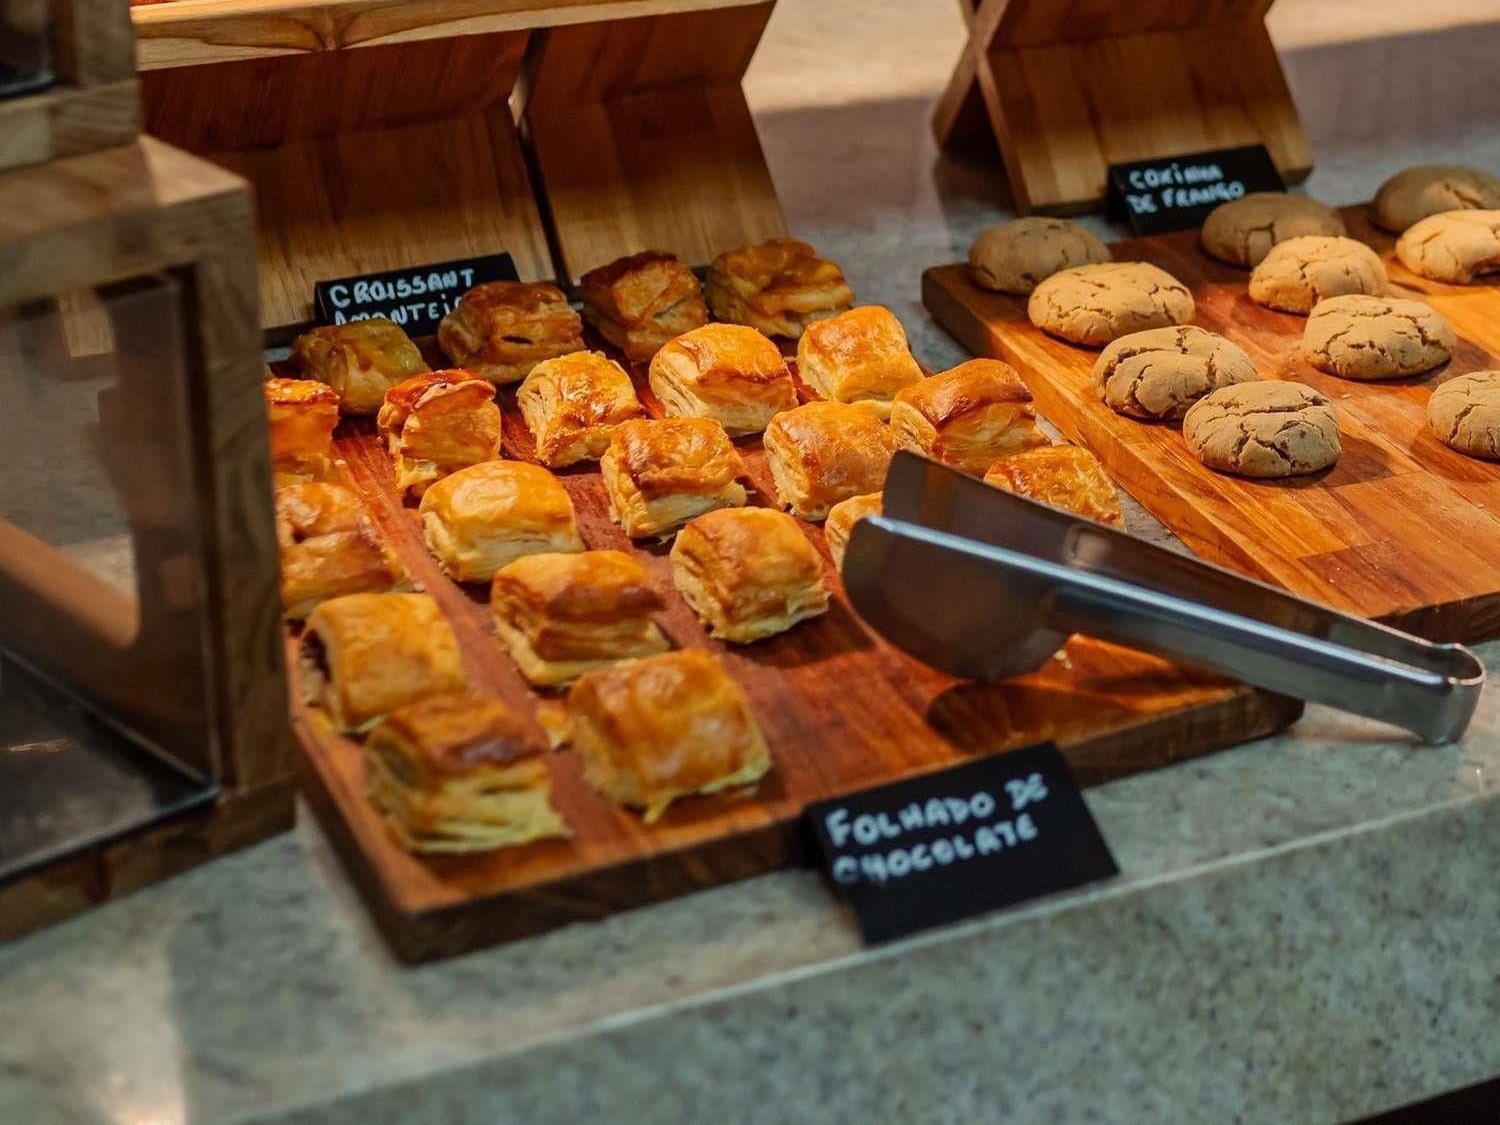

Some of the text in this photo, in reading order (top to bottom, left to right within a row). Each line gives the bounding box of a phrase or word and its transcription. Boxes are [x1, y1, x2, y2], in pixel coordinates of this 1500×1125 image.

[1161, 181, 1245, 207] FRANGO
[329, 269, 474, 308] CROISSANT
[825, 773, 1048, 847] FOLHADO DE
